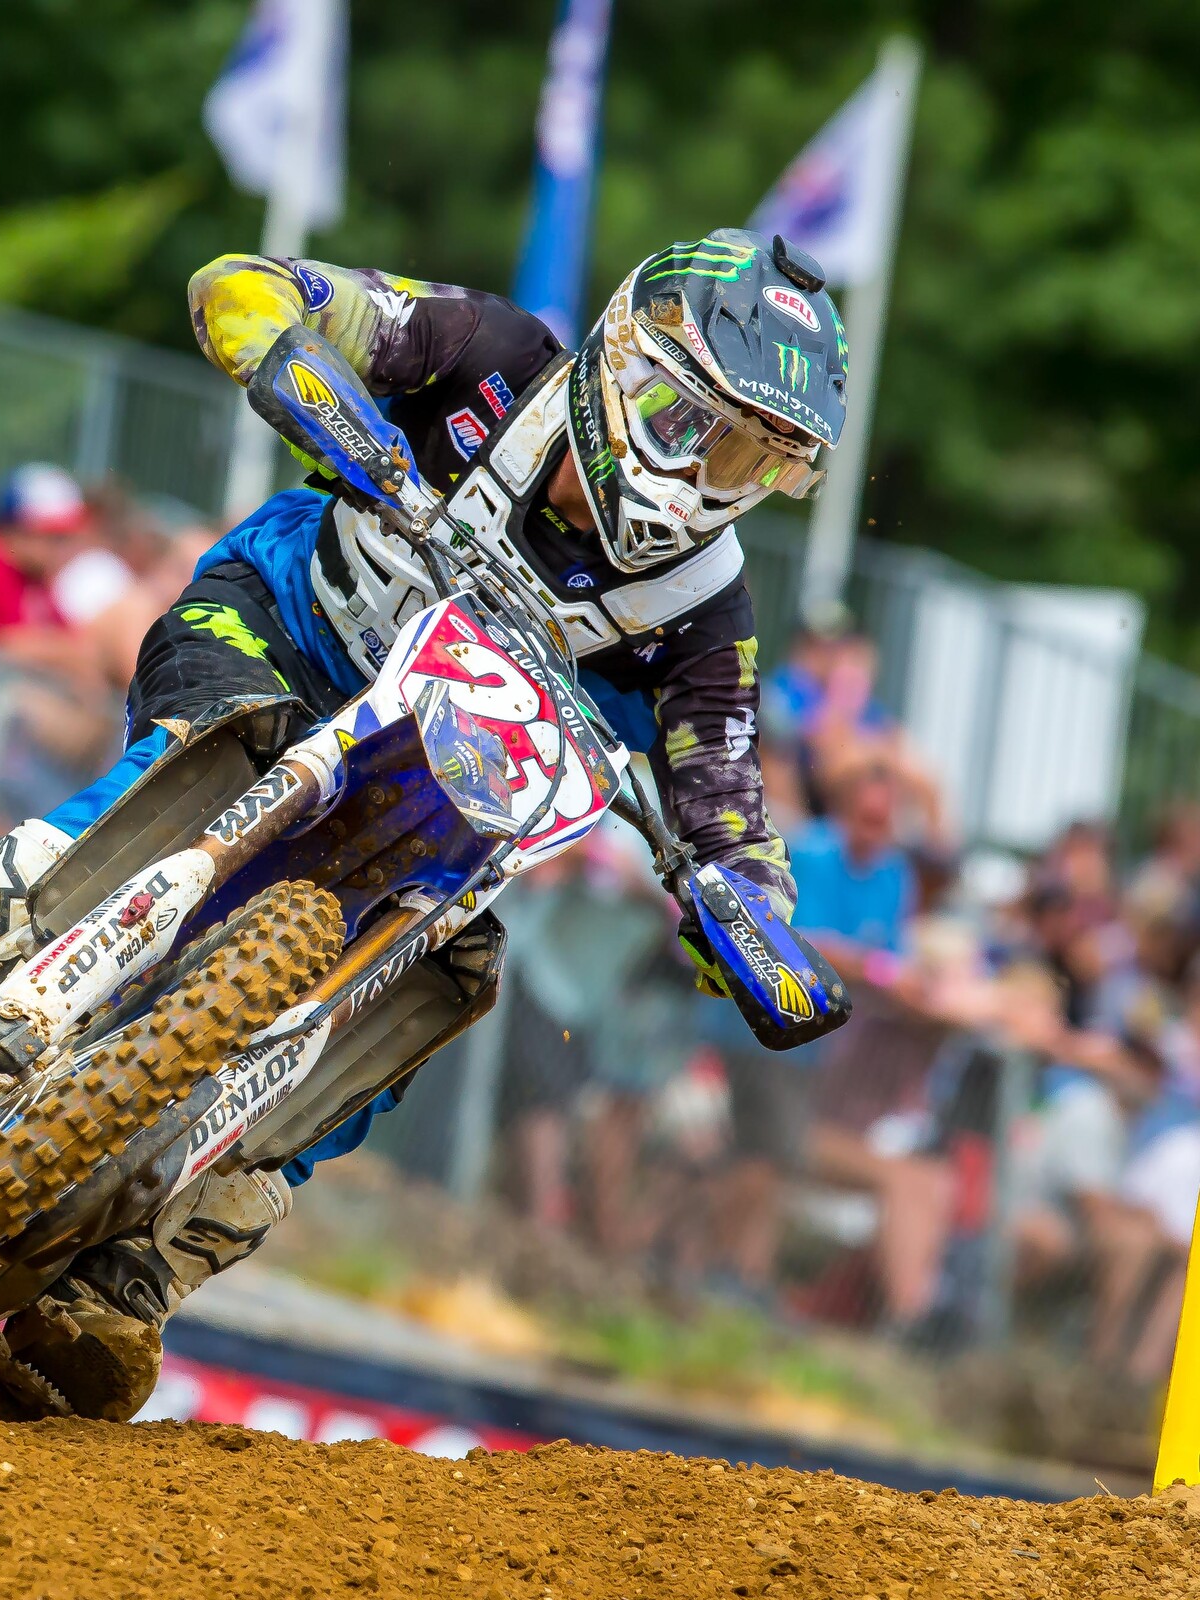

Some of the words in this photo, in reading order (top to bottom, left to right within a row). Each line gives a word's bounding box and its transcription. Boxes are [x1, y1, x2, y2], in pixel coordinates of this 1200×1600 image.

[774, 291, 813, 326] BELL
[684, 323, 709, 355] FLEX
[578, 348, 600, 450] MONSTER
[739, 378, 834, 440] MONSTER
[755, 395, 823, 435] ENERGY
[315, 400, 377, 461] CYCRA
[453, 418, 484, 454] 100
[667, 503, 690, 522] BELL
[400, 641, 595, 838] 23
[561, 706, 586, 738] OIL
[454, 740, 479, 785] YAMAHA
[28, 928, 84, 977] BRAKING
[57, 870, 173, 994] DNLOP
[731, 920, 784, 987] CYCRA
[190, 1037, 306, 1156] DUNLOP
[189, 1123, 245, 1179] BRAKING
